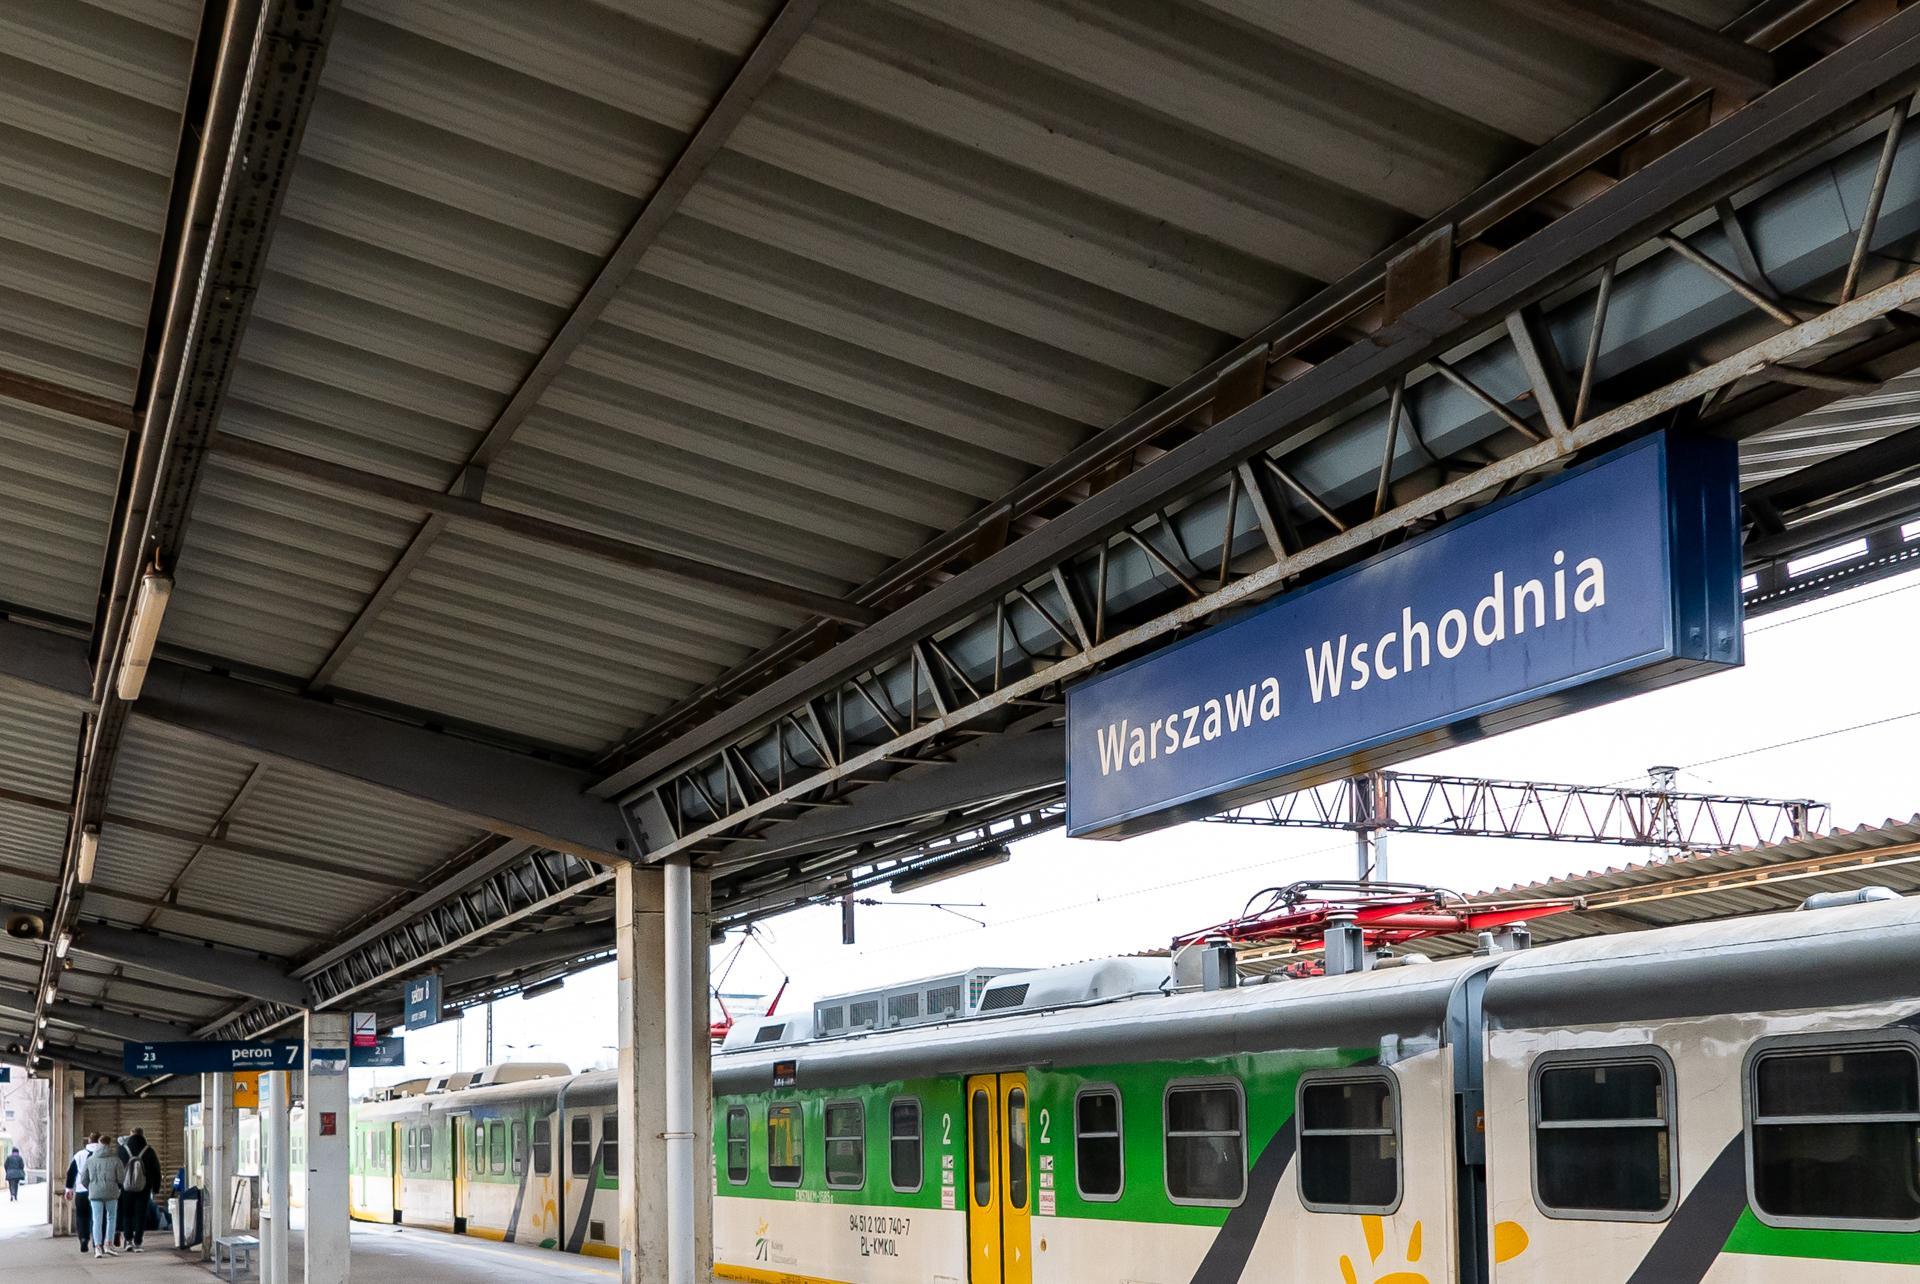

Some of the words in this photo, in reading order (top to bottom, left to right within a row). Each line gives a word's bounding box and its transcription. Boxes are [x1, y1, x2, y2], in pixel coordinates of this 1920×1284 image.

[1098, 676, 1281, 777] Warszawa
[1305, 550, 1605, 704] Wschodnia
[143, 1052, 156, 1062] 23
[231, 1048, 272, 1061] peron
[285, 1045, 299, 1064] 7
[942, 1113, 951, 1145] 2
[1040, 1108, 1051, 1144] 2
[849, 1214, 858, 1231] 94
[859, 1215, 866, 1232] 51
[868, 1216, 873, 1233] 2
[874, 1216, 887, 1234] 120
[889, 1217, 910, 1236] 740-7
[860, 1236, 899, 1257] PL-KMKOL
